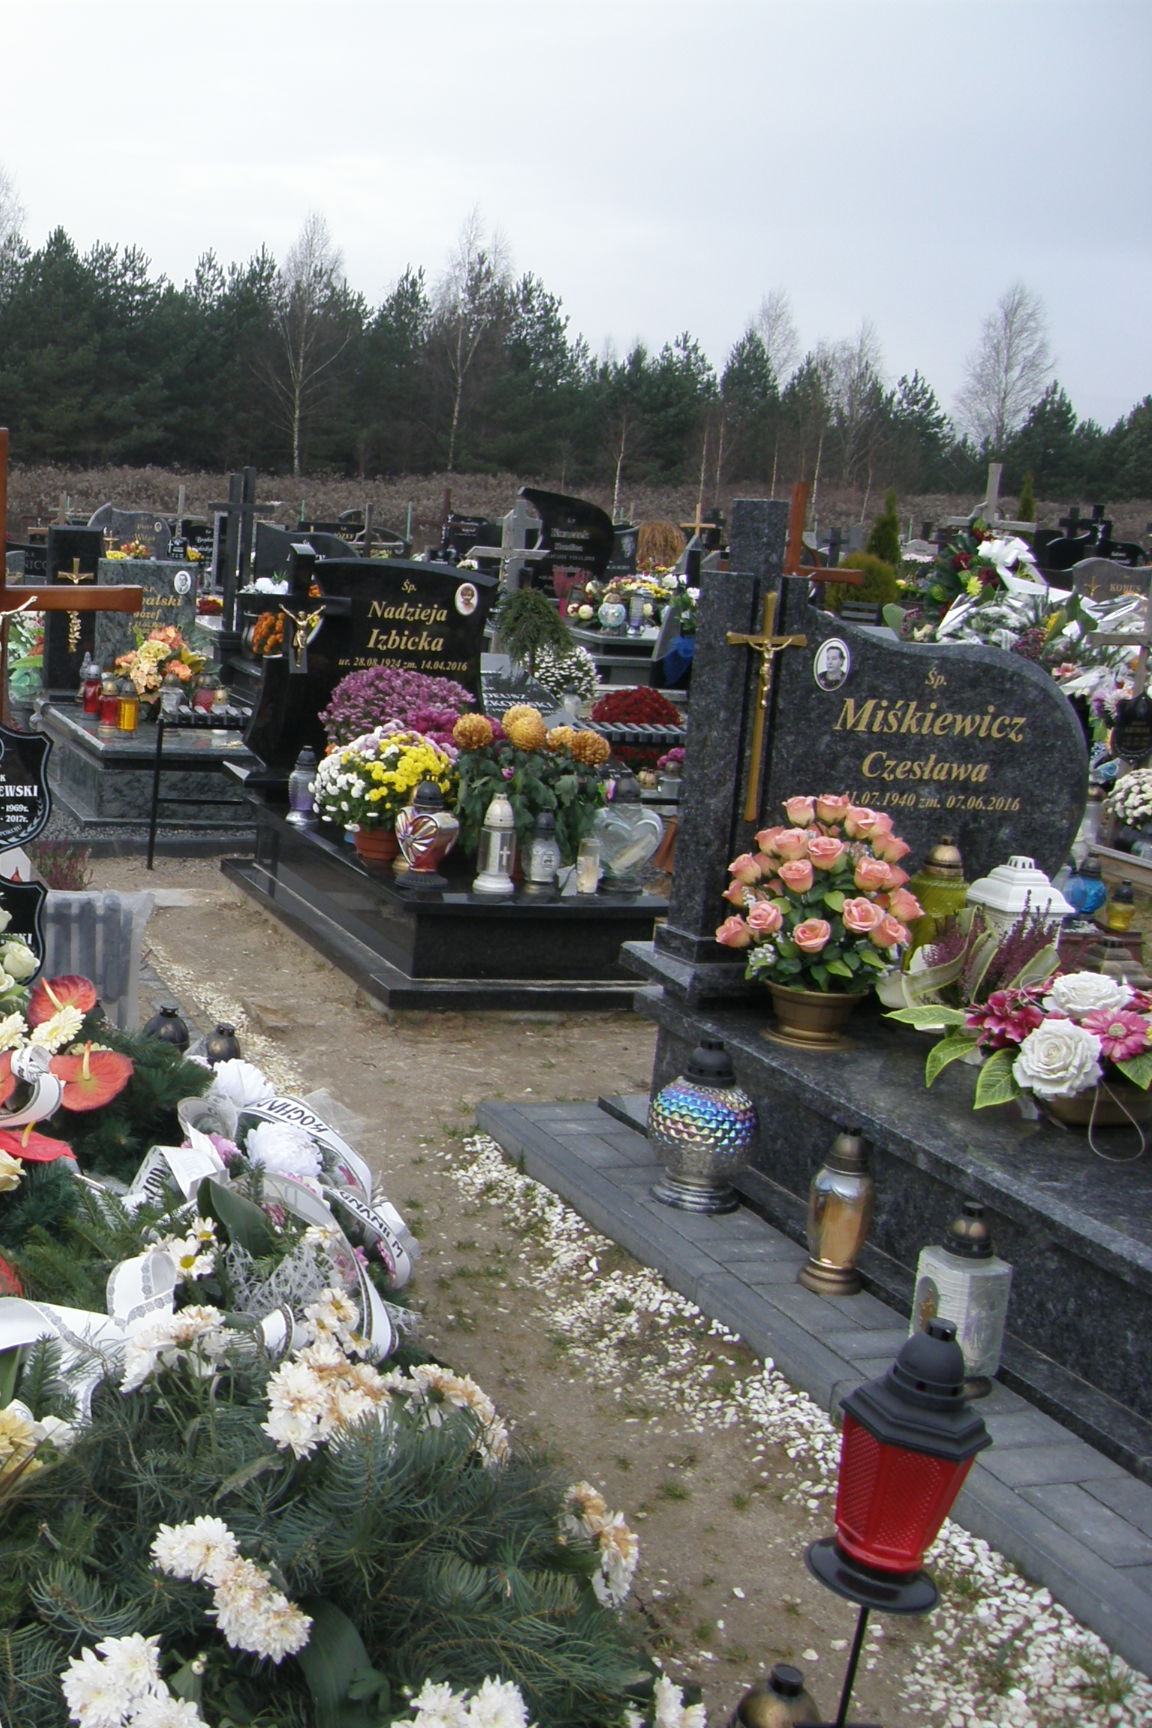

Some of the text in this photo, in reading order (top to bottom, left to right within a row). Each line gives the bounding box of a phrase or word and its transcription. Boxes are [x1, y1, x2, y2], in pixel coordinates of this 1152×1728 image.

[401, 579, 417, 593] Śp.
[368, 600, 448, 625] Nadzieja
[366, 628, 445, 651] Izbicka
[420, 659, 468, 671] 14.04.2016
[924, 667, 948, 689] Śp.
[832, 697, 1027, 742] Miśkiewicz
[861, 750, 990, 782] Czesława
[946, 794, 1021, 812] 07.06.2016
